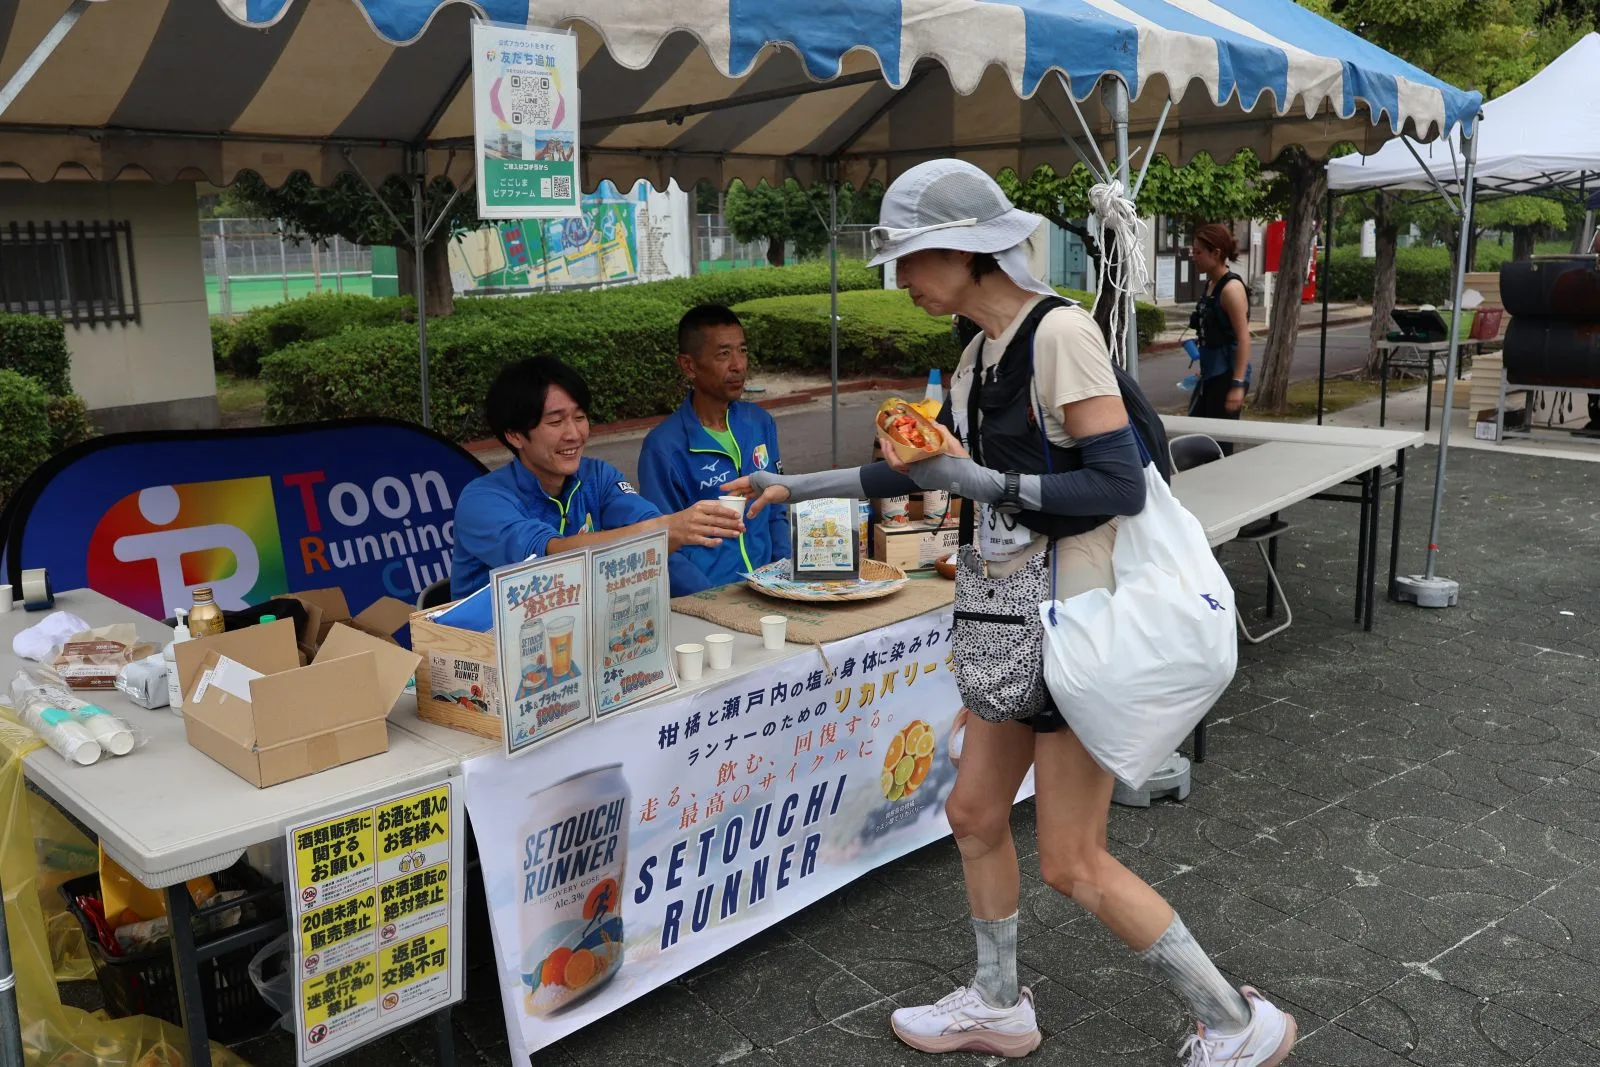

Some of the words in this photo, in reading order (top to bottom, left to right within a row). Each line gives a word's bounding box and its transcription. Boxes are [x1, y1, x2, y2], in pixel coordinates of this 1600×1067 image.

[500, 51, 555, 67] 友だち追加
[493, 189, 536, 198] ビアファーム
[499, 178, 529, 188] ごごしま
[283, 470, 453, 532] Toon
[507, 573, 565, 606] キンキンに
[523, 584, 581, 618] 冷えてます!
[453, 659, 480, 672] SETOUCHI
[454, 669, 479, 682] RUNNER
[604, 668, 625, 684] 2本で
[679, 739, 874, 830] 最高のサイクルに
[377, 796, 448, 833] お酒をご購入の
[297, 815, 372, 850] 酒類販売に
[383, 821, 445, 854] お客様へ
[523, 798, 625, 870] SETOUCHI
[634, 774, 848, 905] SETOUCHI
[310, 851, 365, 883] お願い
[312, 836, 360, 865] 関する
[381, 869, 447, 904] 飲酒運転の
[523, 835, 618, 903] RUNNER
[384, 886, 444, 923] 絶対禁止
[540, 882, 578, 904] RECOVERY
[580, 875, 600, 888] GOSE
[661, 833, 822, 951] RUNNER
[303, 895, 375, 933] 20歳未満への
[310, 914, 372, 951] 販売禁止
[382, 948, 446, 989] 交換不可
[307, 973, 375, 1011] 迷惑行為の
[327, 994, 358, 1018] 禁止
